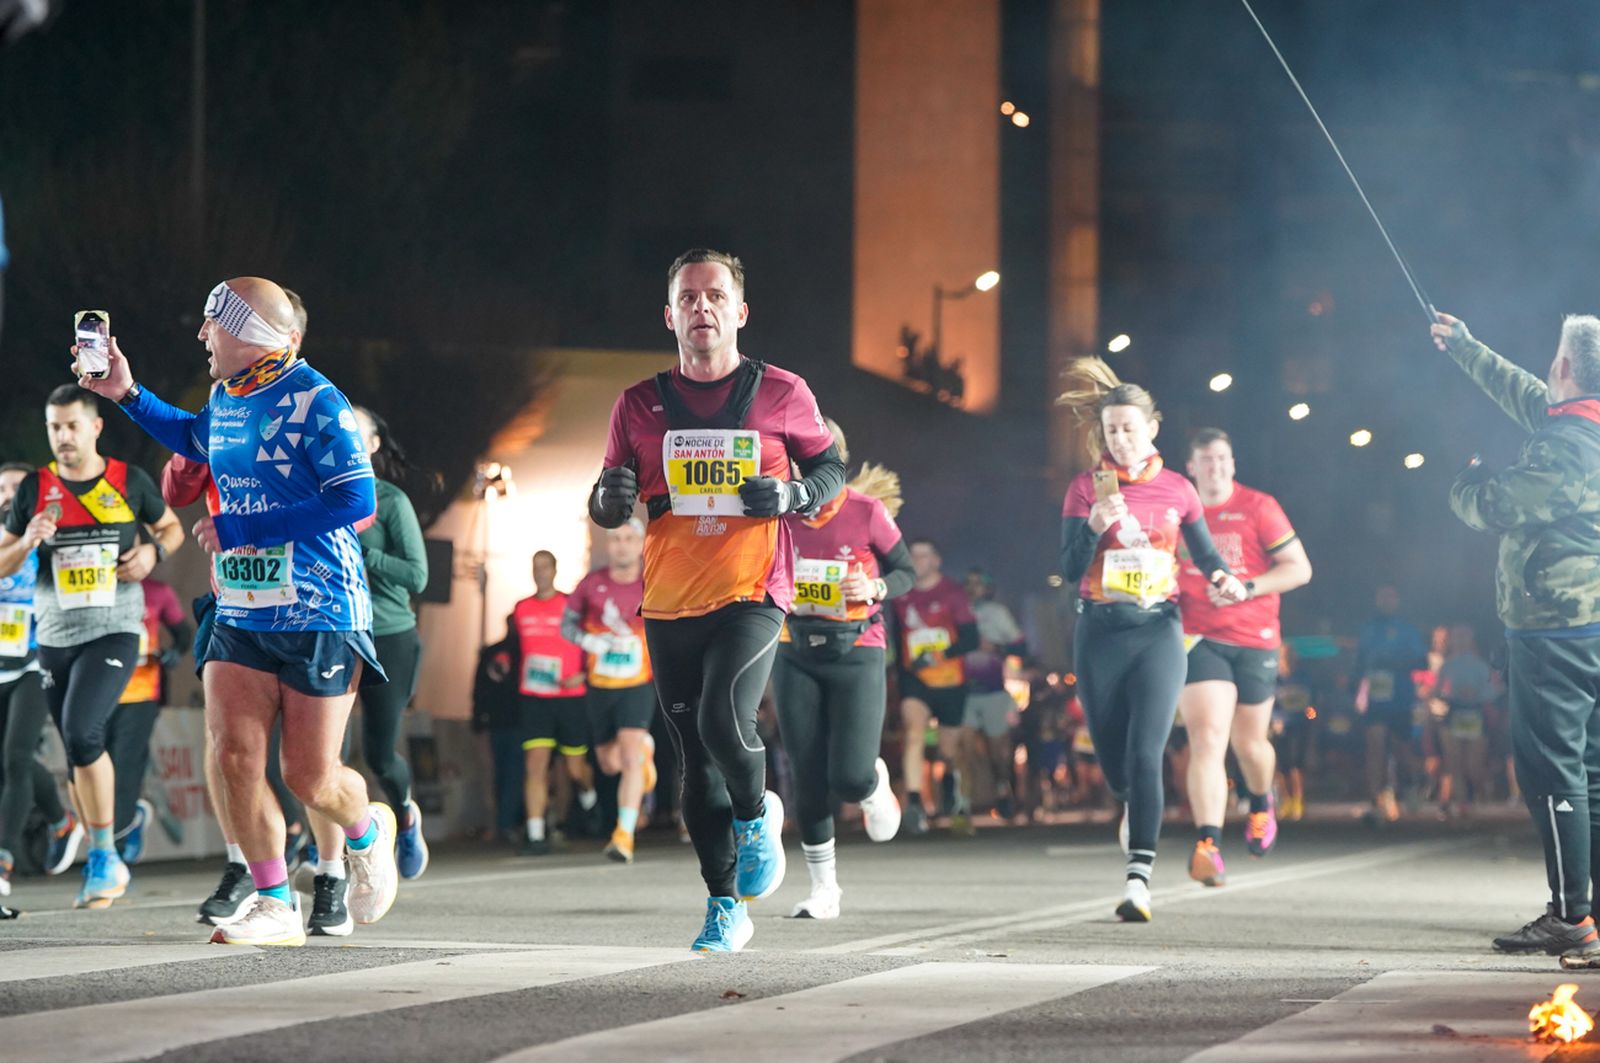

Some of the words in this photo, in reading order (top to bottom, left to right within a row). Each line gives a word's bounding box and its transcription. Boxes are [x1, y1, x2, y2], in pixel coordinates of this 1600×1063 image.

[674, 450, 692, 458] SAN
[694, 448, 725, 458] ANTÓN
[685, 439, 712, 448] NOCHE
[714, 439, 725, 447] DE
[683, 461, 741, 485] 1065
[221, 556, 281, 582] 13302
[795, 582, 831, 601] 560
